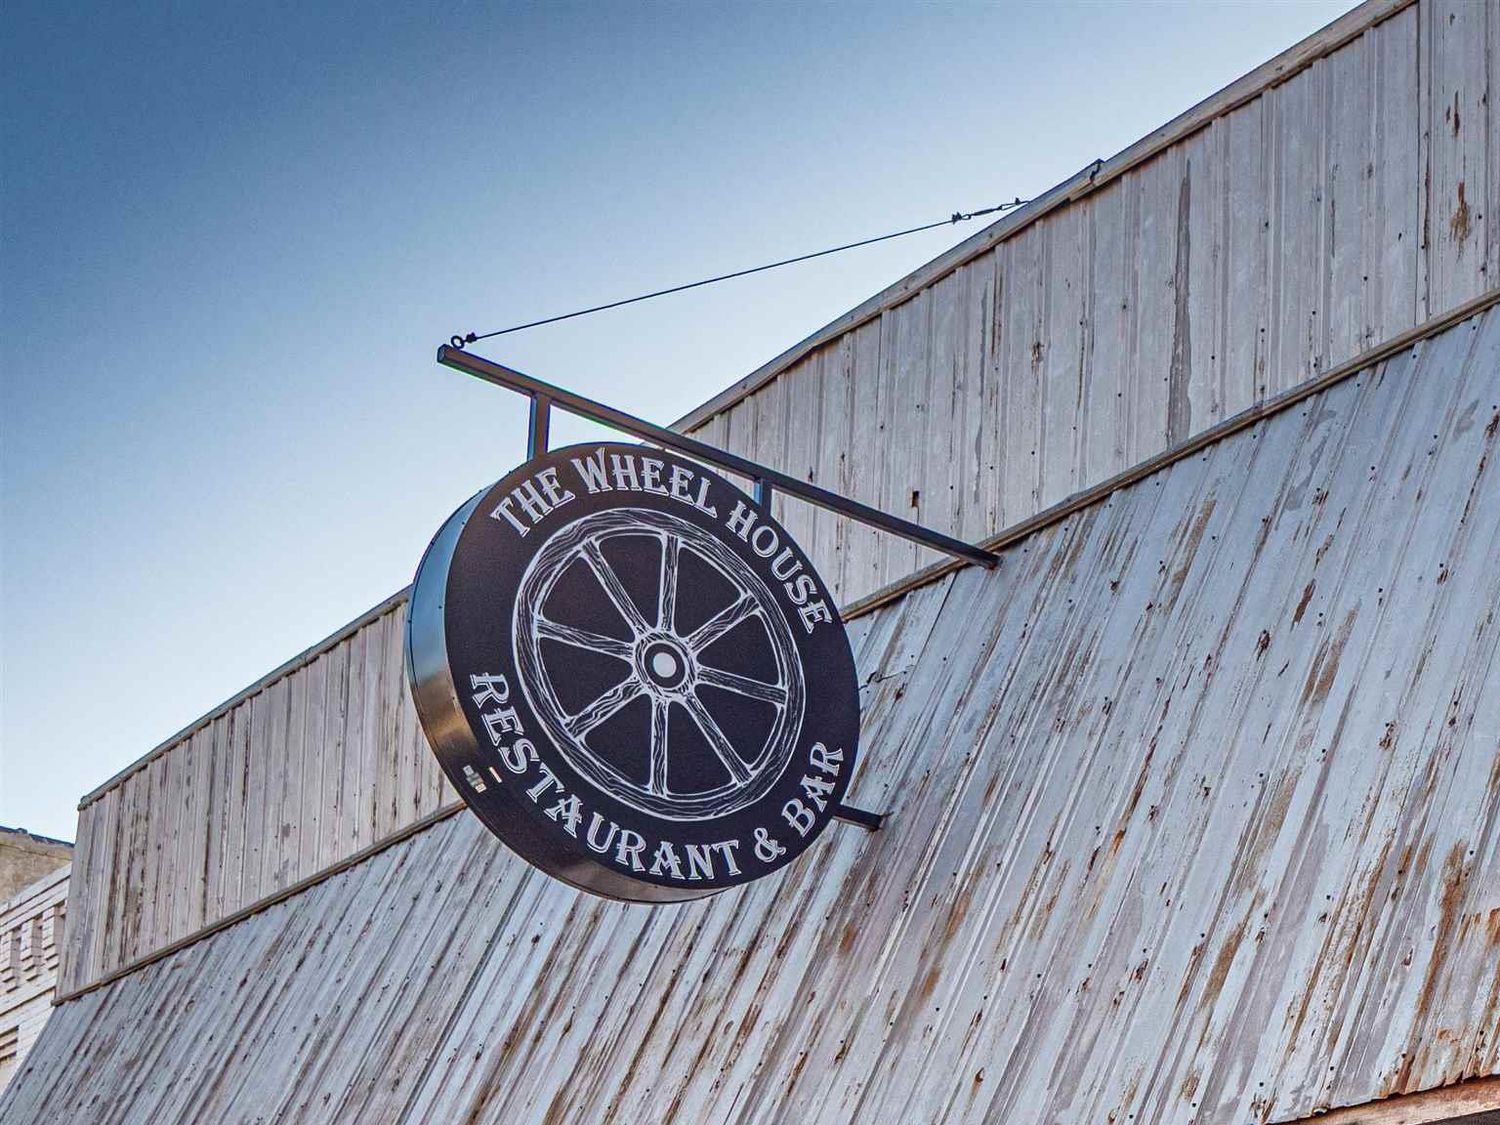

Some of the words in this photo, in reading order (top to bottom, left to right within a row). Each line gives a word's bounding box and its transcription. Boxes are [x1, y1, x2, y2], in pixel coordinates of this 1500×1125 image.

[490, 467, 575, 537] THE
[571, 447, 717, 519] WHEEL
[725, 500, 833, 634] HOUSE
[469, 672, 742, 881] RESTAURANT
[754, 827, 787, 863] &
[781, 741, 844, 838] BAR
